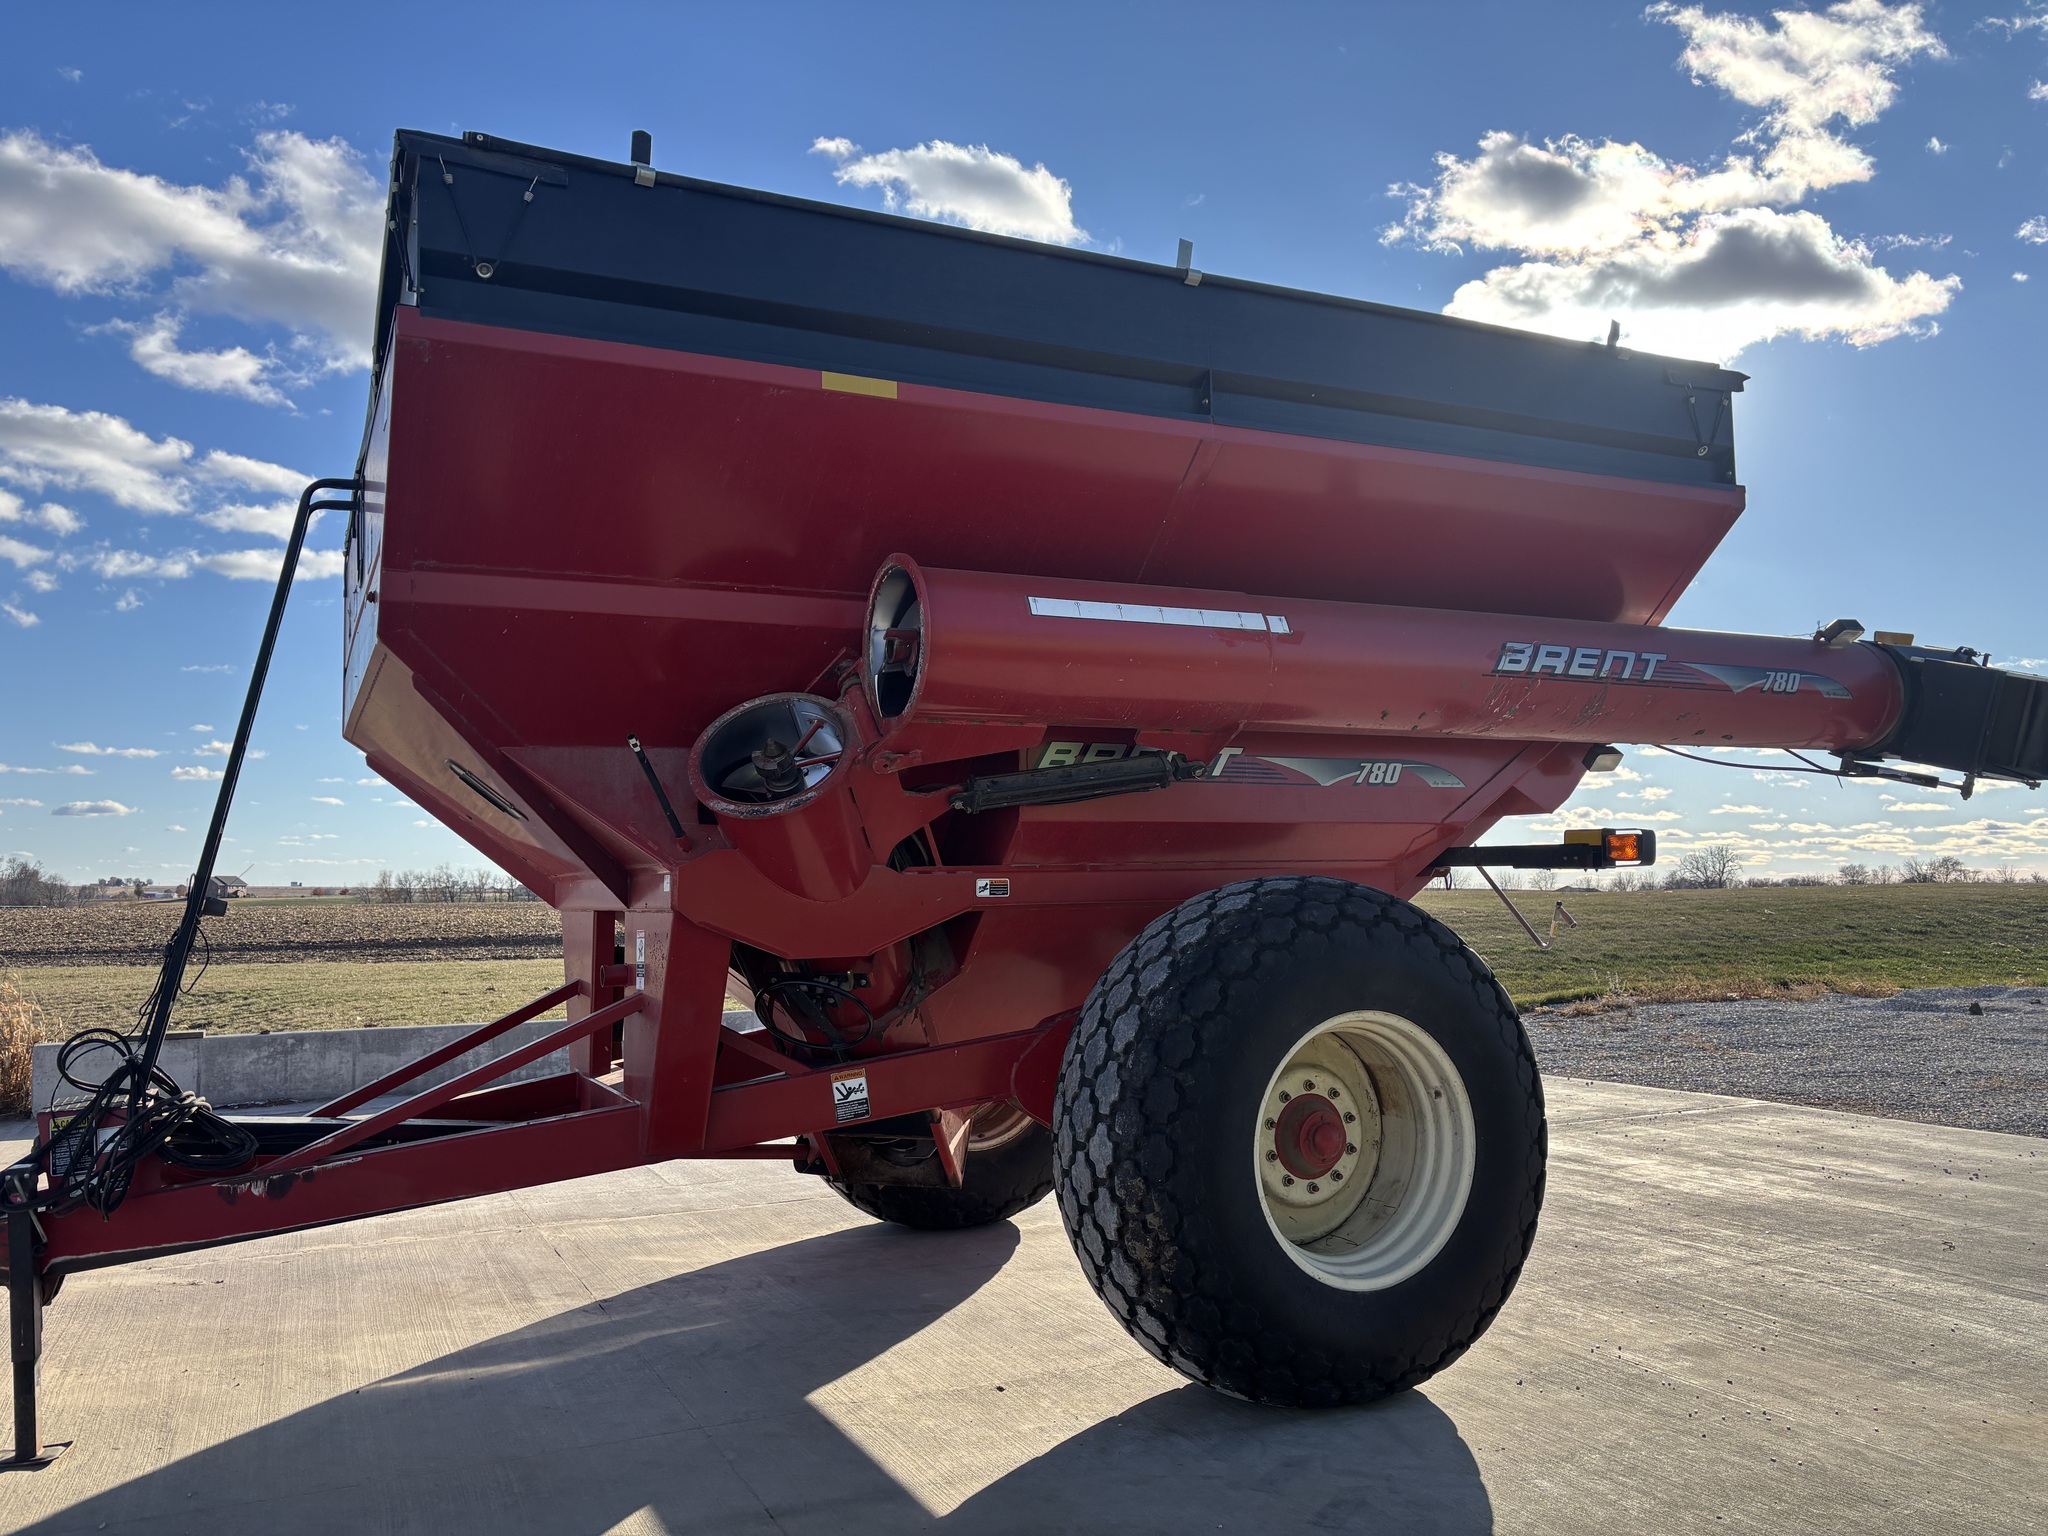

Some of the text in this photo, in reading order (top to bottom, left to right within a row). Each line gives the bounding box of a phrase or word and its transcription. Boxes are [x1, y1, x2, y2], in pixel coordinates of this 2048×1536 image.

[1496, 641, 1801, 693] BRENT 780
[1036, 741, 1403, 784] BRT 780
